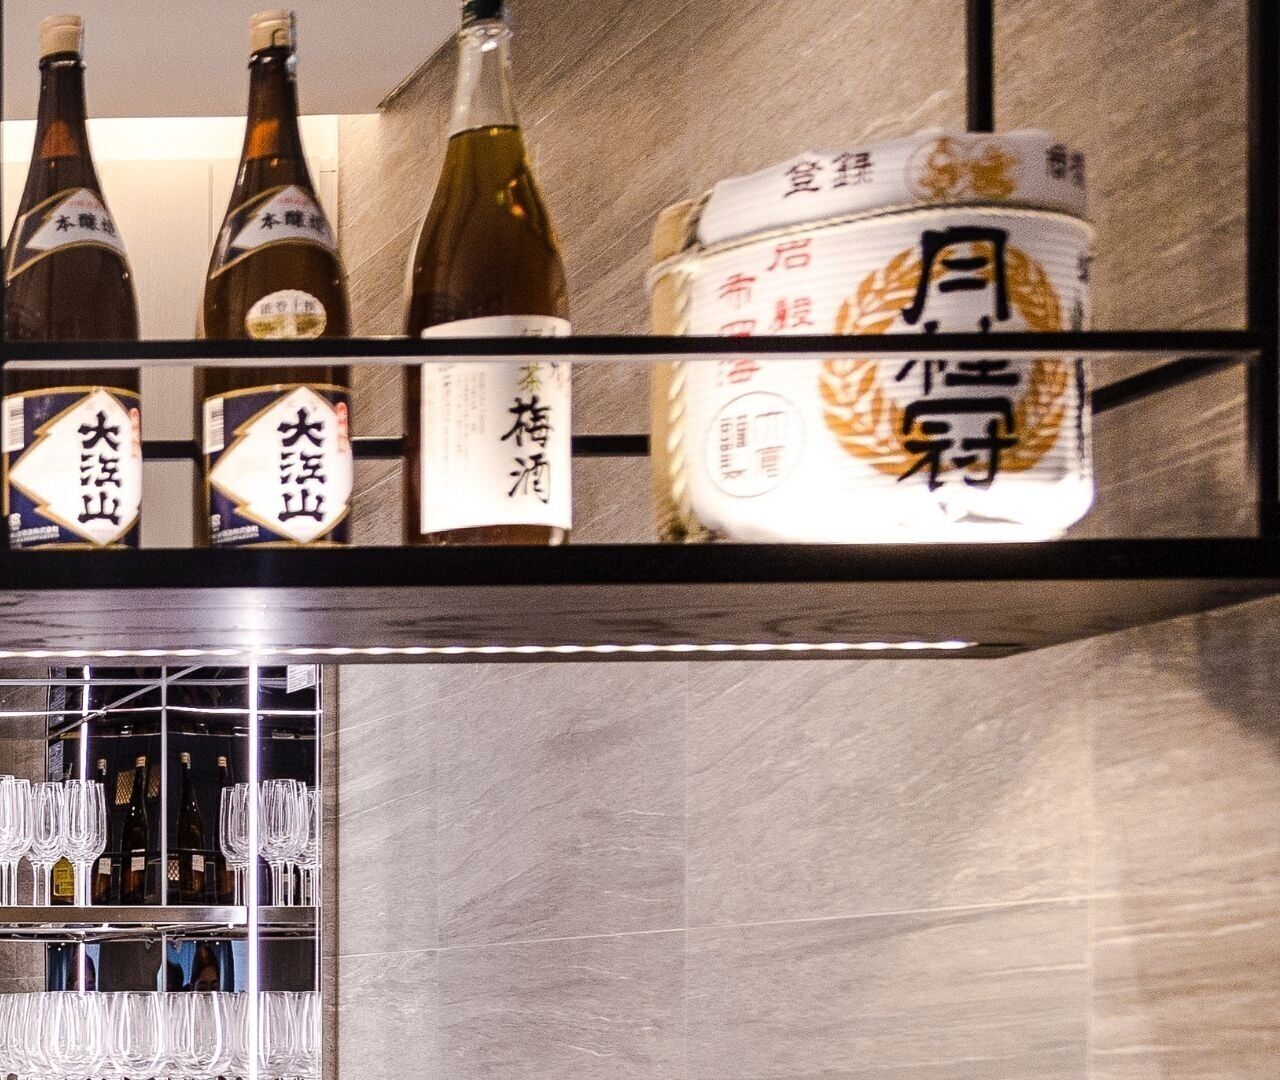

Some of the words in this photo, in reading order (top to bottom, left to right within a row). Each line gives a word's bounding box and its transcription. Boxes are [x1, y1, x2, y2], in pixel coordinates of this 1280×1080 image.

[77, 410, 123, 526] 大江山
[277, 407, 328, 523] 大江山
